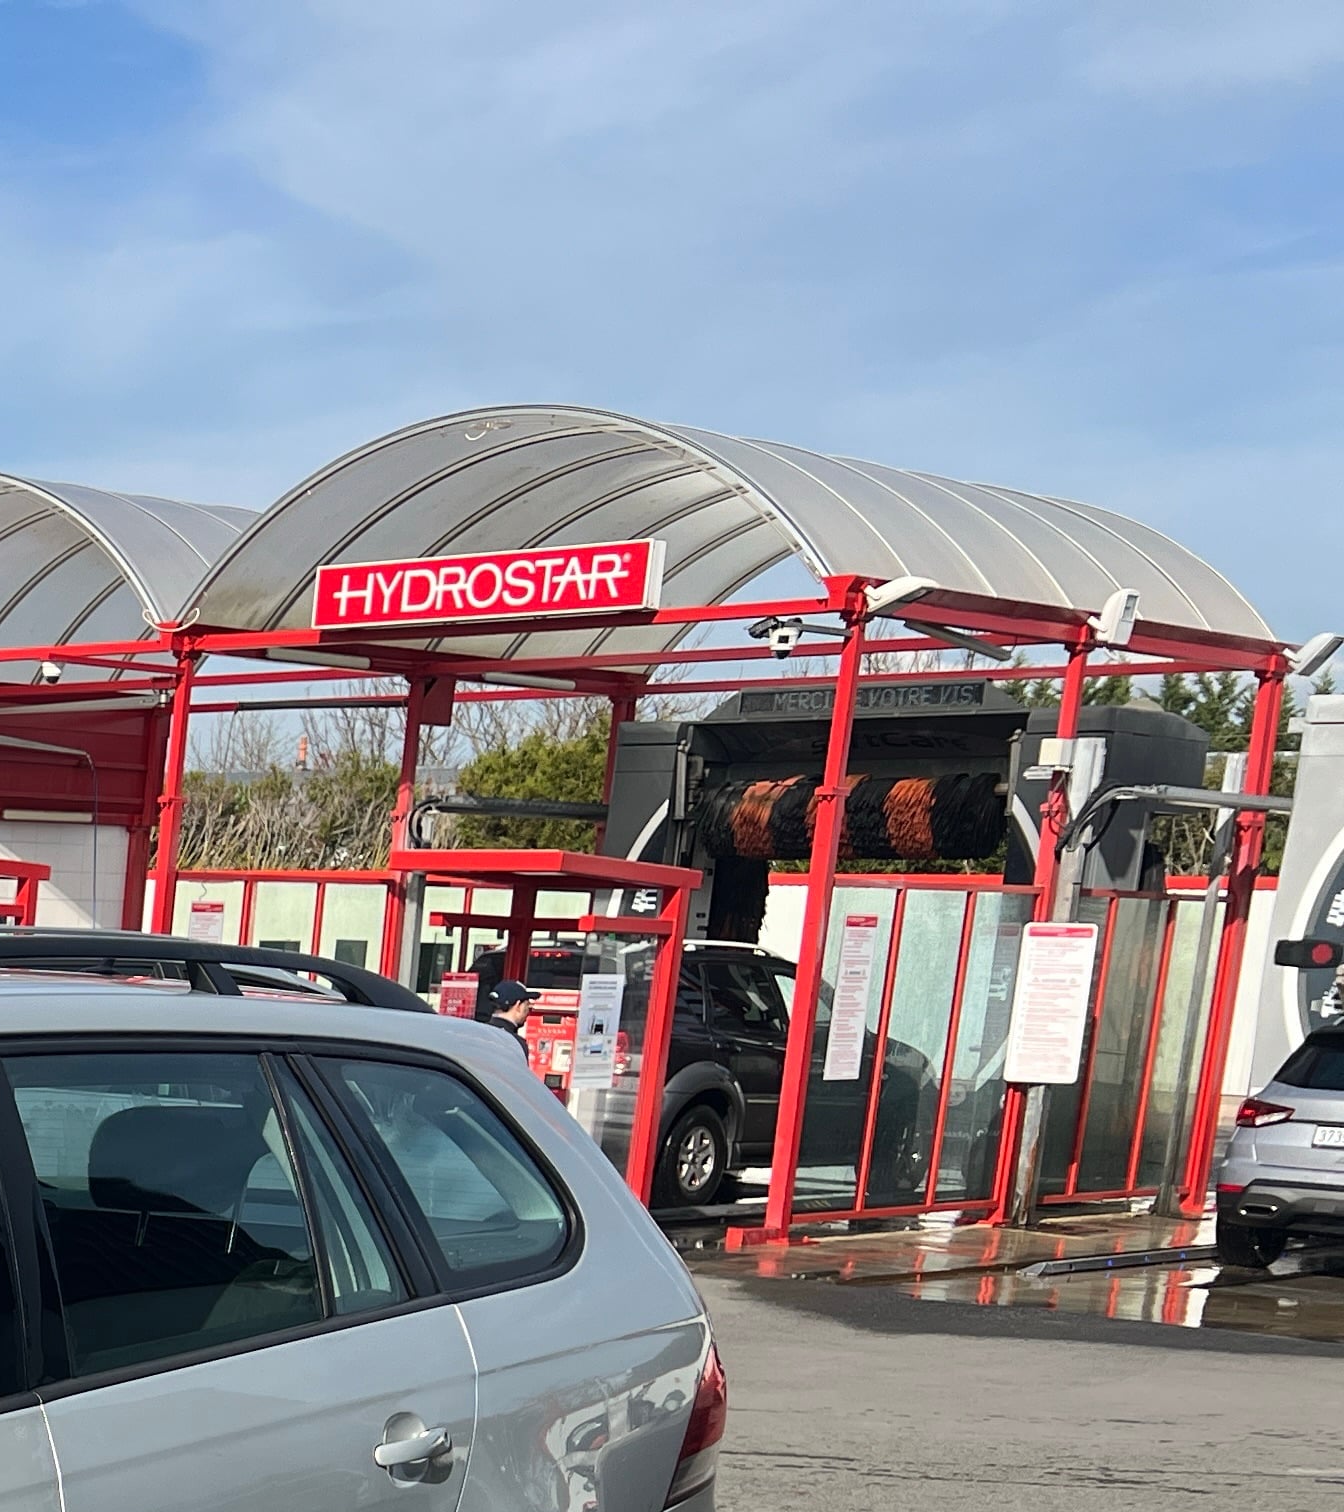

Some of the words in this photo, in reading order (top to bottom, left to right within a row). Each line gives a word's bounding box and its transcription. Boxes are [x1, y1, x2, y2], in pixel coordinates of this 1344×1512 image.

[332, 552, 630, 617] HYDROSTAR
[773, 690, 830, 712] MERCI
[868, 686, 933, 708] VOTRE
[1318, 1129, 1344, 1143] 373
